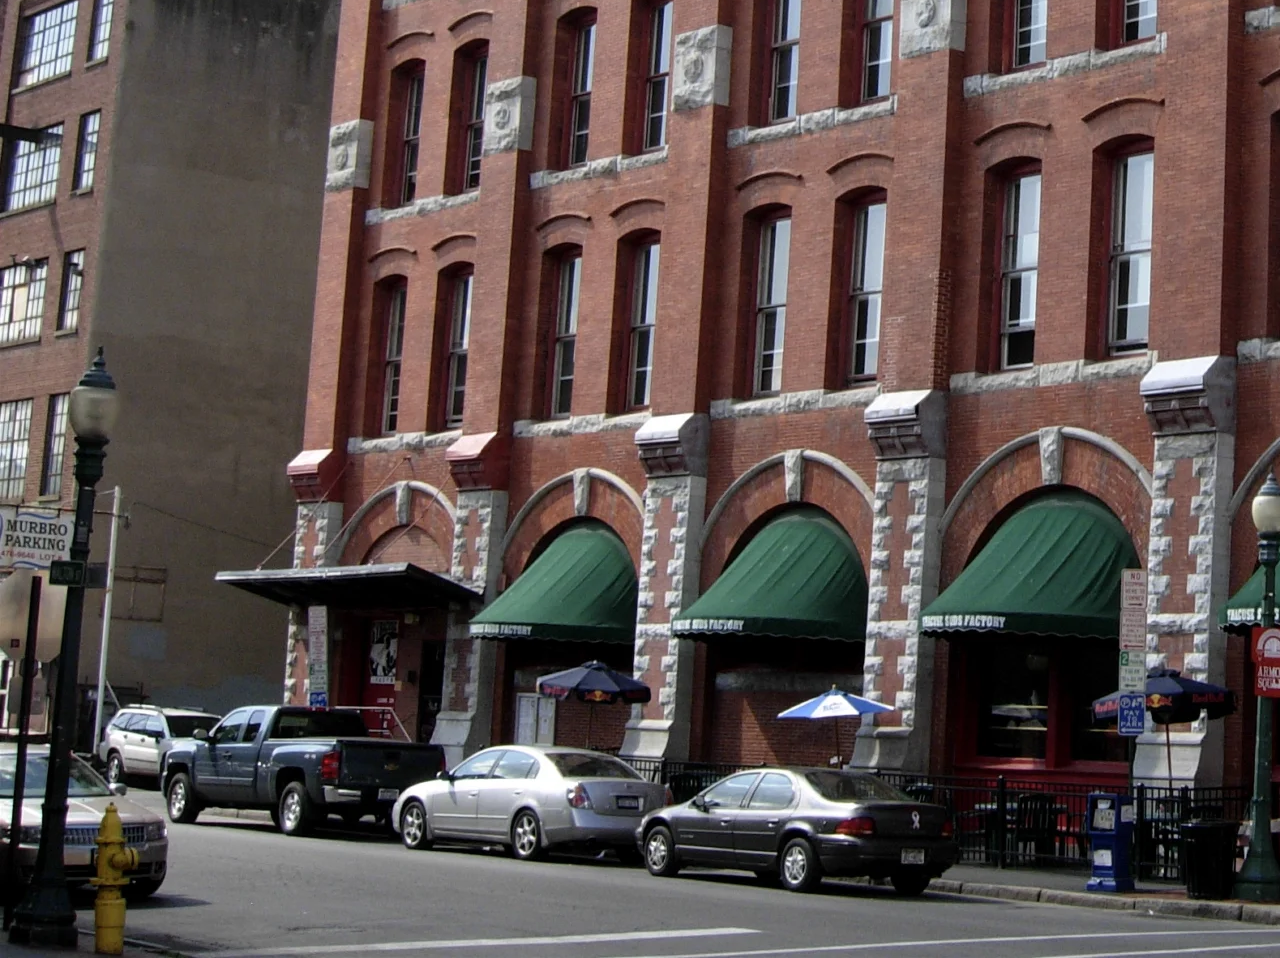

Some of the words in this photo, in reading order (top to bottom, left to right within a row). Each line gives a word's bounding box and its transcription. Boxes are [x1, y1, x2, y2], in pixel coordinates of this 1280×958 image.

[7, 519, 68, 536] MURBRO
[5, 534, 66, 551] PARKING
[709, 619, 745, 631] FACTORY
[964, 615, 1006, 628] FACTORY
[500, 624, 533, 636] FACTORY
[1122, 653, 1128, 664] 2
